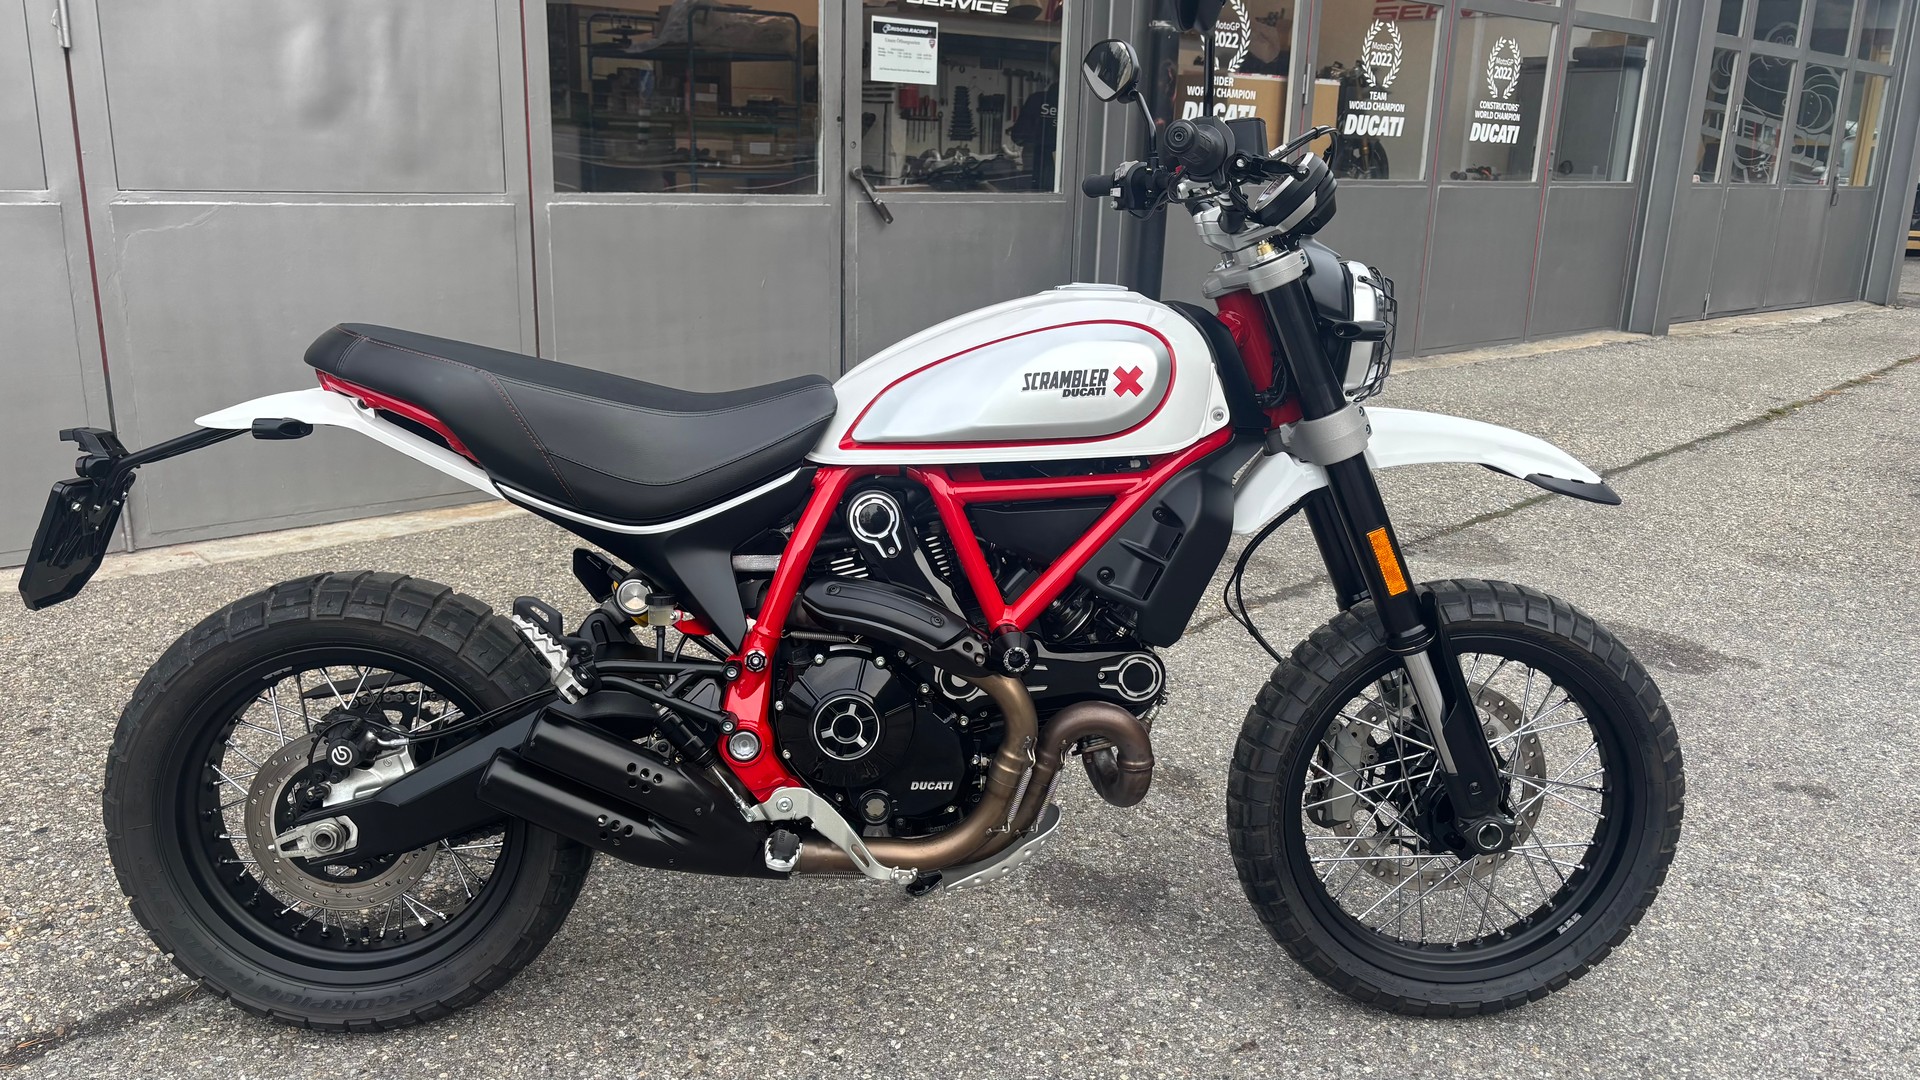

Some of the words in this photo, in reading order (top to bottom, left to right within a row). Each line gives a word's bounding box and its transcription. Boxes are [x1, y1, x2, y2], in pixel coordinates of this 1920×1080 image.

[1215, 31, 1239, 48] 2022
[1372, 41, 1394, 51] MotoGP
[1370, 52, 1393, 67] 2022
[1495, 57, 1514, 66] MotoGP
[1494, 66, 1513, 81] 2022
[1187, 85, 1215, 97] WOR
[1216, 87, 1257, 100] CHAMPION
[1369, 91, 1387, 101] TEAM
[1349, 100, 1372, 111] WORLD
[1372, 102, 1405, 113] CHAMPION
[1474, 110, 1494, 119] WORLD
[1494, 111, 1521, 122] CHAMPION
[1344, 114, 1405, 137] DUCATI
[1469, 122, 1520, 144] DUCATI
[1021, 368, 1110, 392] SCRAMBLER
[1062, 386, 1107, 398] DUCATI
[910, 781, 954, 791] DUCATI
[257, 985, 417, 1010] SCORPION
